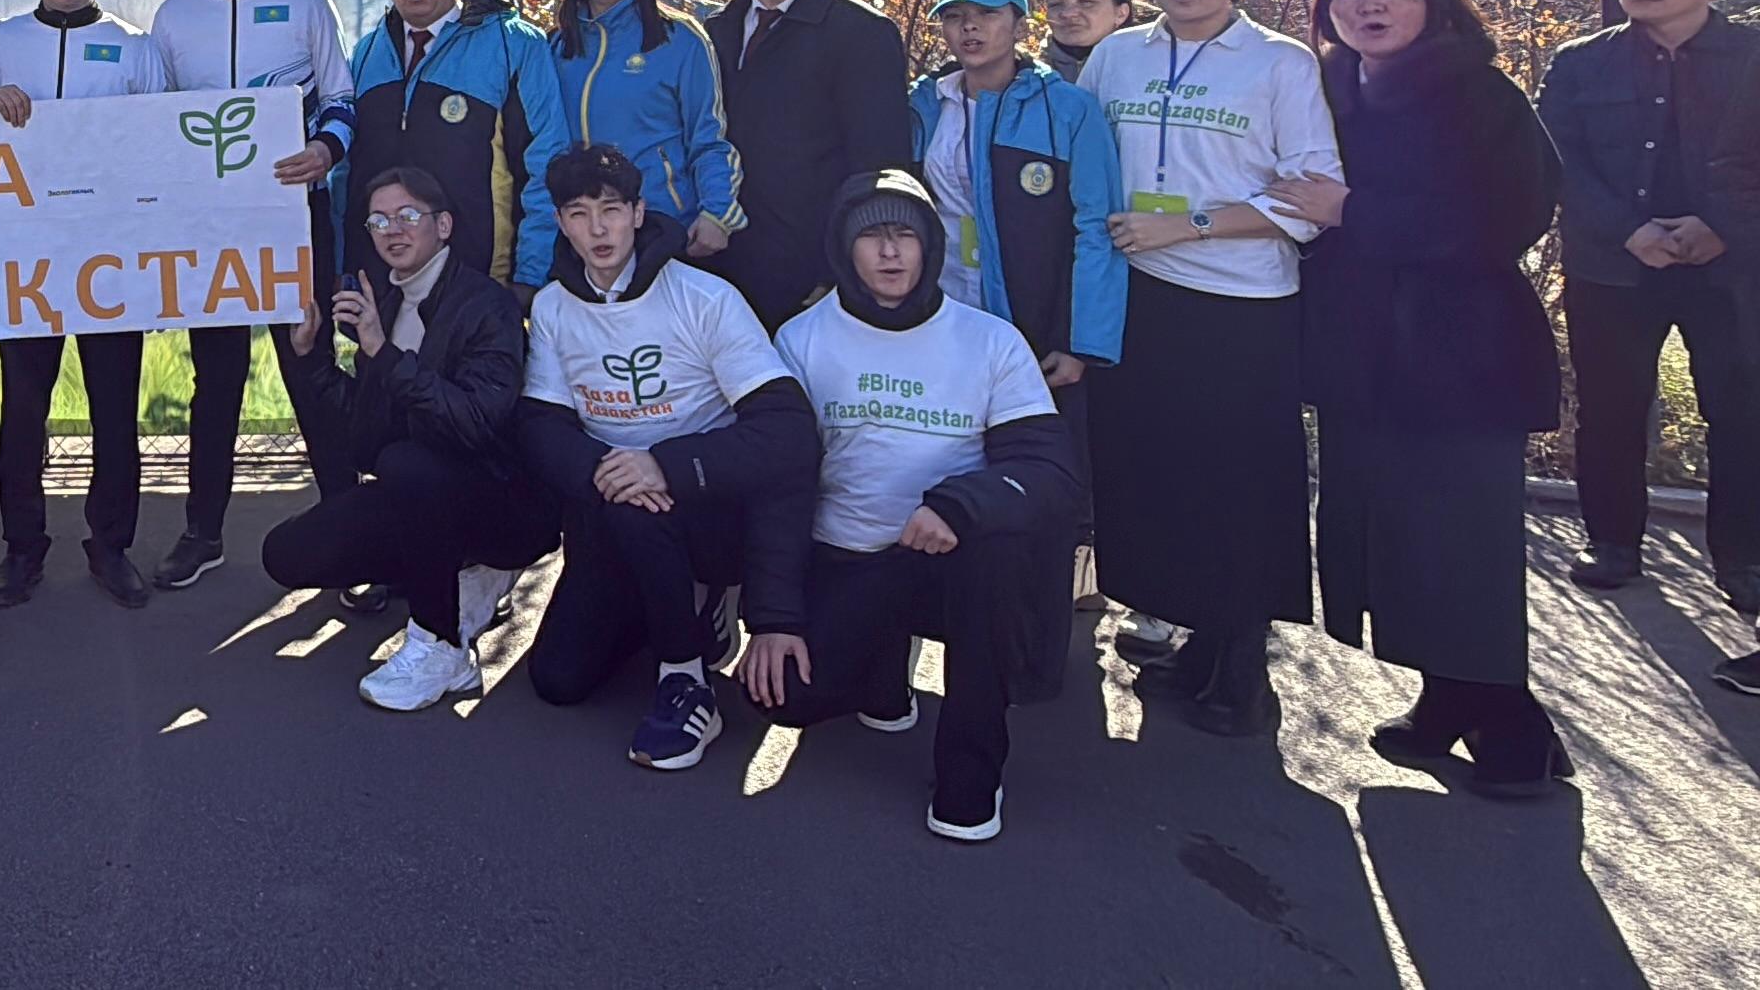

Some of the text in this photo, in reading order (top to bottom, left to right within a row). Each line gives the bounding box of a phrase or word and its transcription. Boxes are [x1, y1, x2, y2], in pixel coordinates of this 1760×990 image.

[1144, 79, 1208, 99] #Brge
[575, 384, 631, 403] Таза
[858, 373, 924, 398] #Birge
[823, 399, 973, 428] #TazaQazaqstan
